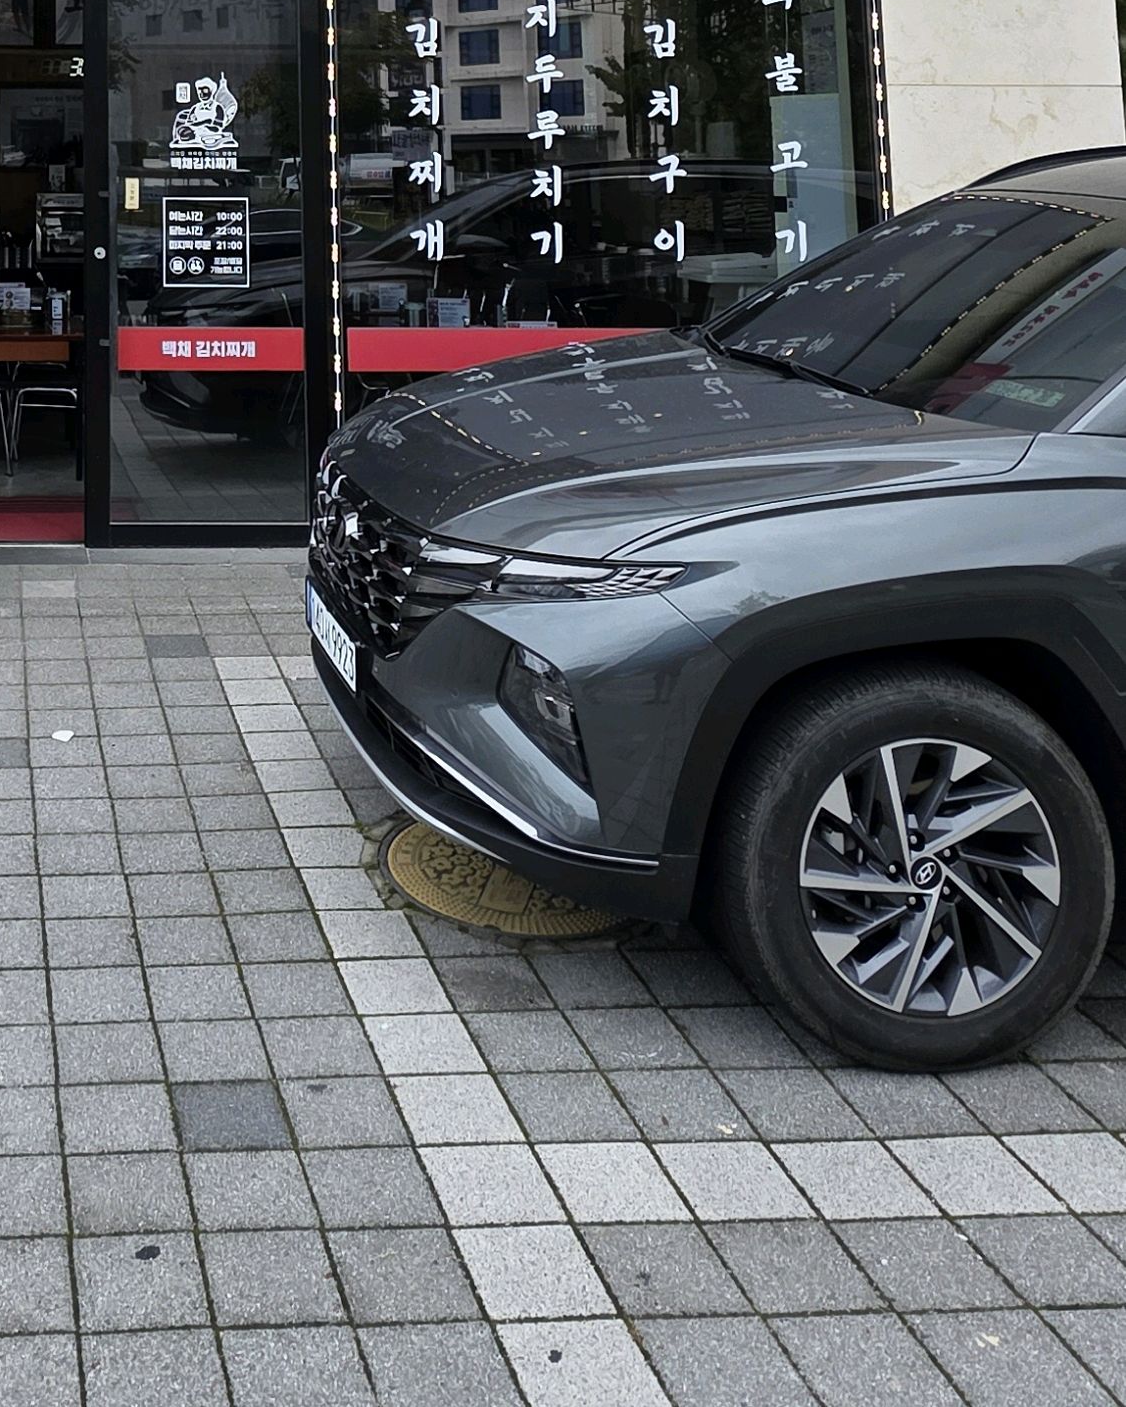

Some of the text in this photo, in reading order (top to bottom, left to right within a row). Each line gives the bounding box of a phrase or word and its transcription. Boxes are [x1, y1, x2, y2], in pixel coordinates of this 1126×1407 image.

[170, 157, 237, 169] 백채김치찌개
[216, 212, 243, 221] 10:00
[215, 226, 243, 235] 22:00
[216, 241, 243, 250] 21:00
[162, 340, 256, 359] 백채 김치찌개
